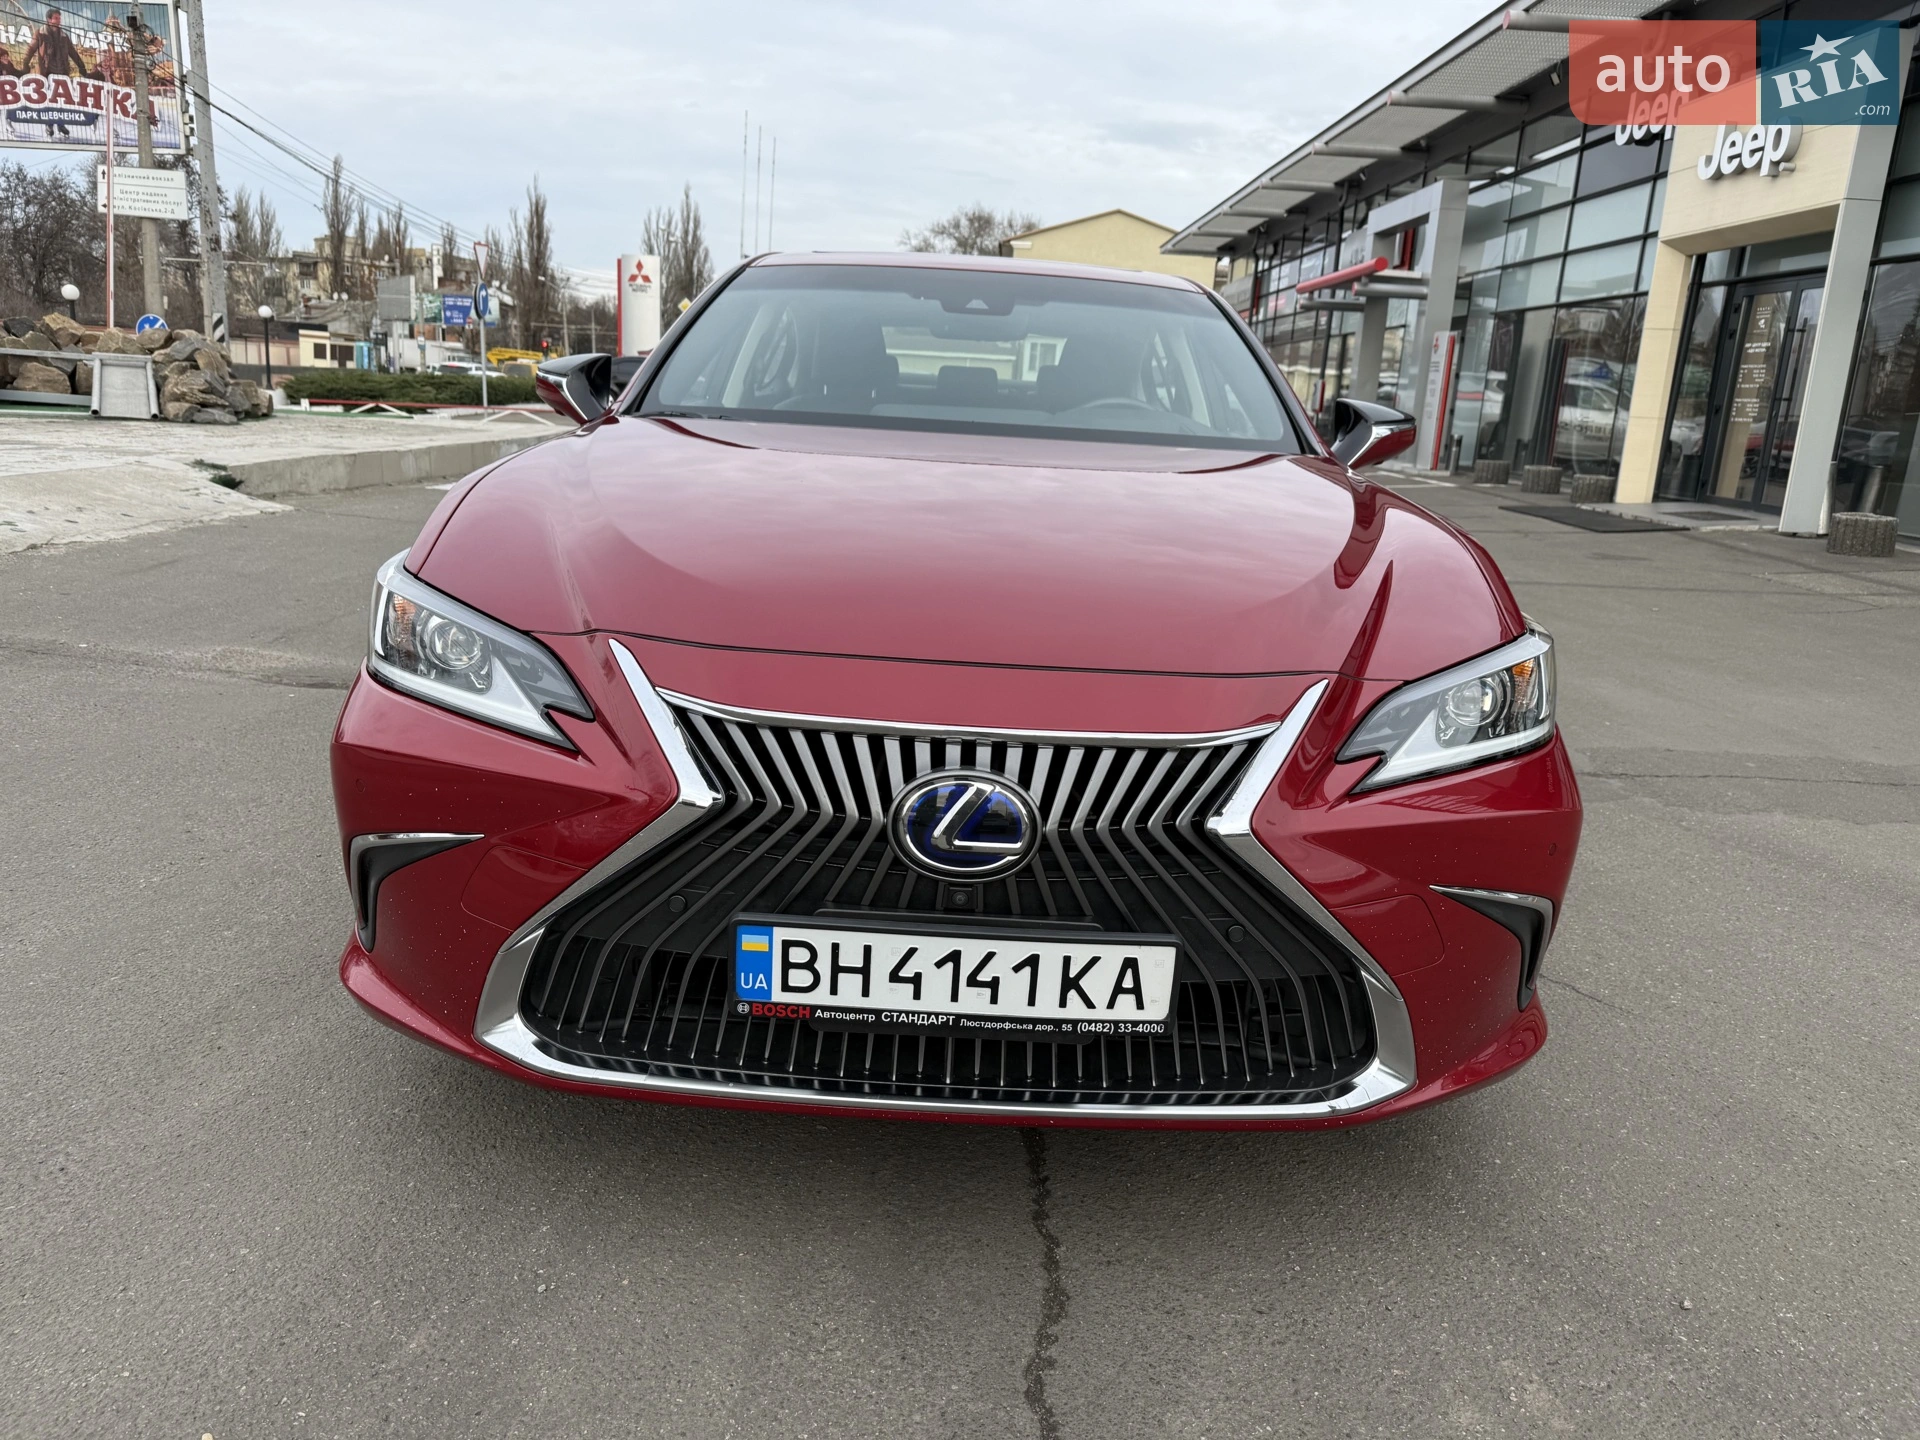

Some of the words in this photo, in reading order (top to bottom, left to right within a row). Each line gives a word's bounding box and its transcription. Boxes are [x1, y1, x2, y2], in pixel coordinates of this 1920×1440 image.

[16, 110, 39, 120] ПАРК
[40, 111, 86, 122] ШЕВЧЕНКА
[1697, 115, 1800, 182] Jeep
[119, 188, 140, 196] Центр
[741, 973, 768, 990] UA
[780, 938, 873, 998] BH
[888, 946, 1041, 1007] 4141
[1058, 954, 1146, 1011] KA
[752, 1002, 811, 1019] BOSCH
[814, 1009, 876, 1022] Автоцентр
[881, 1011, 956, 1026] СТАНДАРТ
[960, 1018, 1033, 1031] Люстдорфська
[1061, 1023, 1073, 1032] 55
[1077, 1022, 1115, 1034] (0482)
[1118, 1023, 1165, 1034] 33-4000
